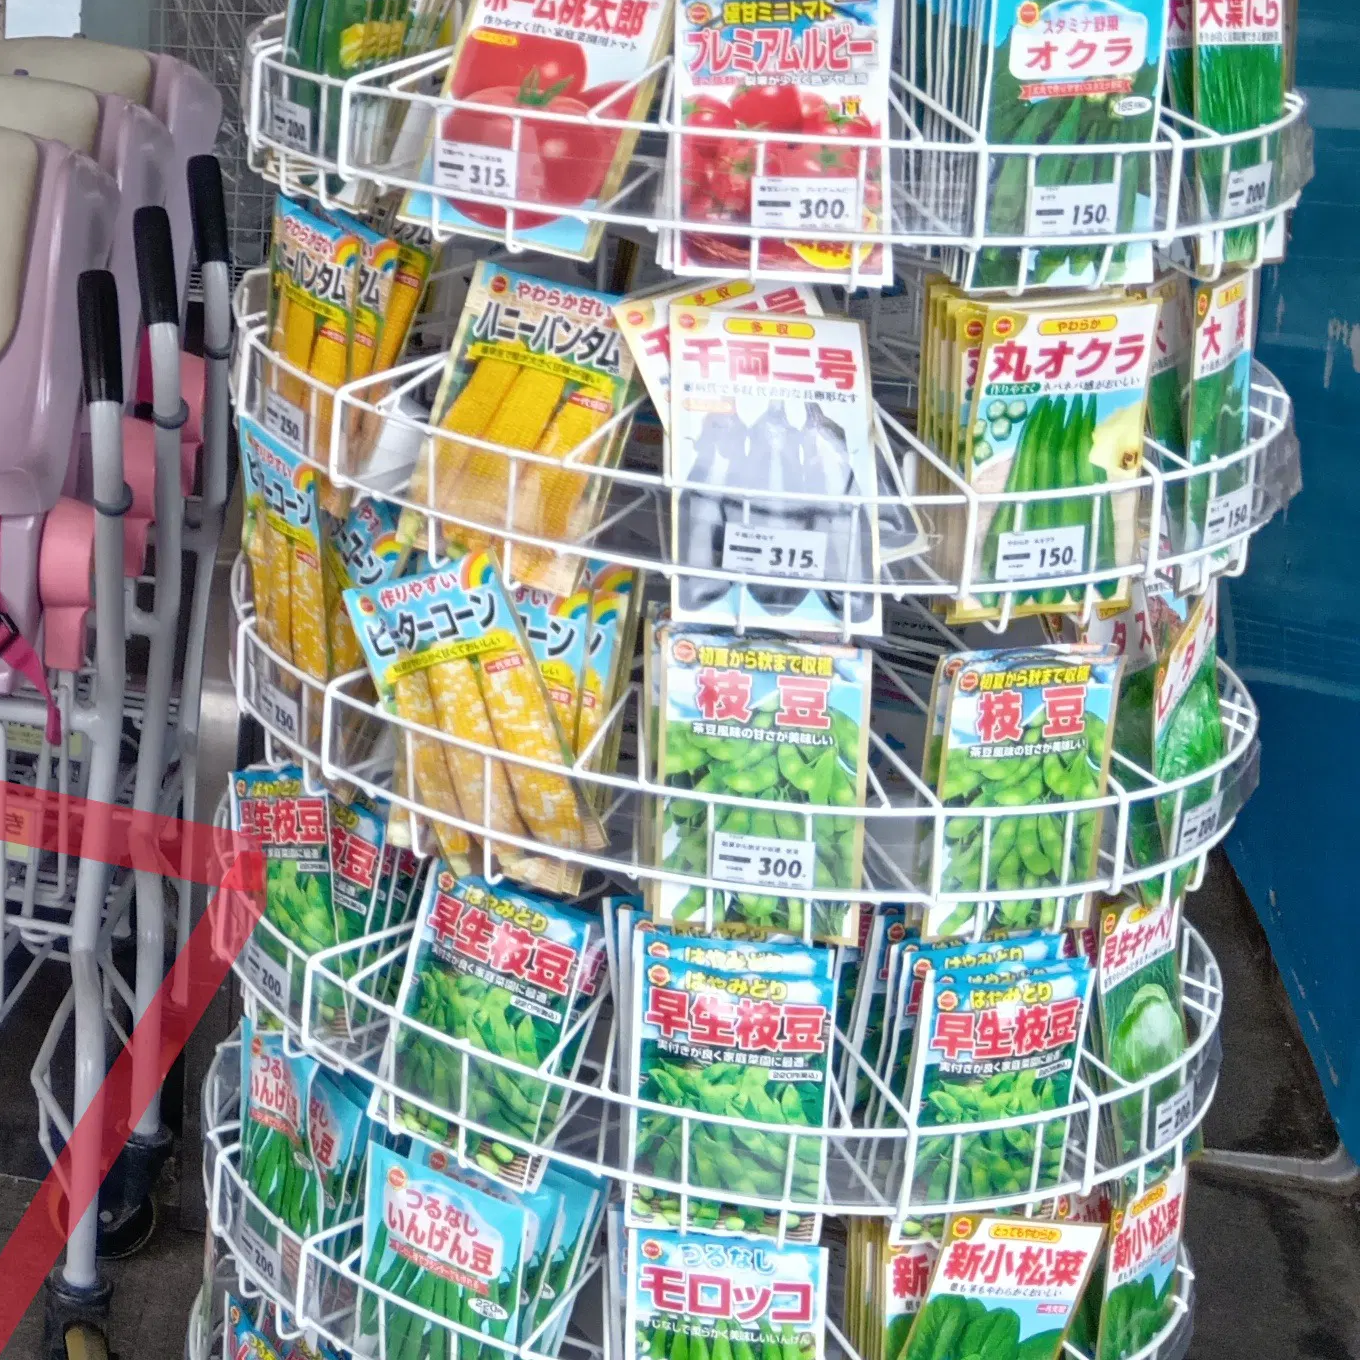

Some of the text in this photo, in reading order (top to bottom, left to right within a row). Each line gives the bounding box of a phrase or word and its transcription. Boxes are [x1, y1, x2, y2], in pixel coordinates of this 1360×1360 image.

[1043, 15, 1121, 36] スタミナ野菜
[687, 24, 876, 75] プレミアムルビー
[1024, 36, 1135, 71] オクラ
[467, 162, 506, 188] 315
[798, 198, 846, 220] 300
[1070, 204, 1108, 225] 150
[516, 280, 613, 319] やわらか甘い
[474, 300, 621, 371] ハニーバンタム
[1056, 318, 1101, 333] やわらか
[682, 337, 858, 391] 千両二号
[988, 332, 1145, 383] 丸オクラ
[768, 546, 814, 569] 315
[1037, 544, 1074, 569] 150
[379, 575, 460, 610] 作りやすい
[698, 645, 833, 677] 初夏から秋まで収穫
[979, 665, 1091, 690] 初夏から秋まで収穫
[695, 667, 831, 729] 枝豆
[976, 686, 1087, 744] 枝豆
[692, 722, 835, 747] 茶豆風味の甘さが美味しい
[757, 856, 803, 879] 300
[427, 890, 577, 995] 早生枝豆
[260, 970, 282, 997] 200
[644, 985, 827, 1055] 早生枝豆
[930, 997, 1082, 1061] 早生枝豆
[404, 1186, 481, 1238] つるなし
[387, 1200, 495, 1278] いんげん豆
[993, 1225, 1059, 1242] とってもやわらか
[1111, 1193, 1183, 1273] 新小松菜
[254, 1251, 276, 1280] 200
[680, 1242, 776, 1275] つるなし
[943, 1240, 1088, 1287] 新小松菜
[640, 1266, 814, 1323] モロッコ
